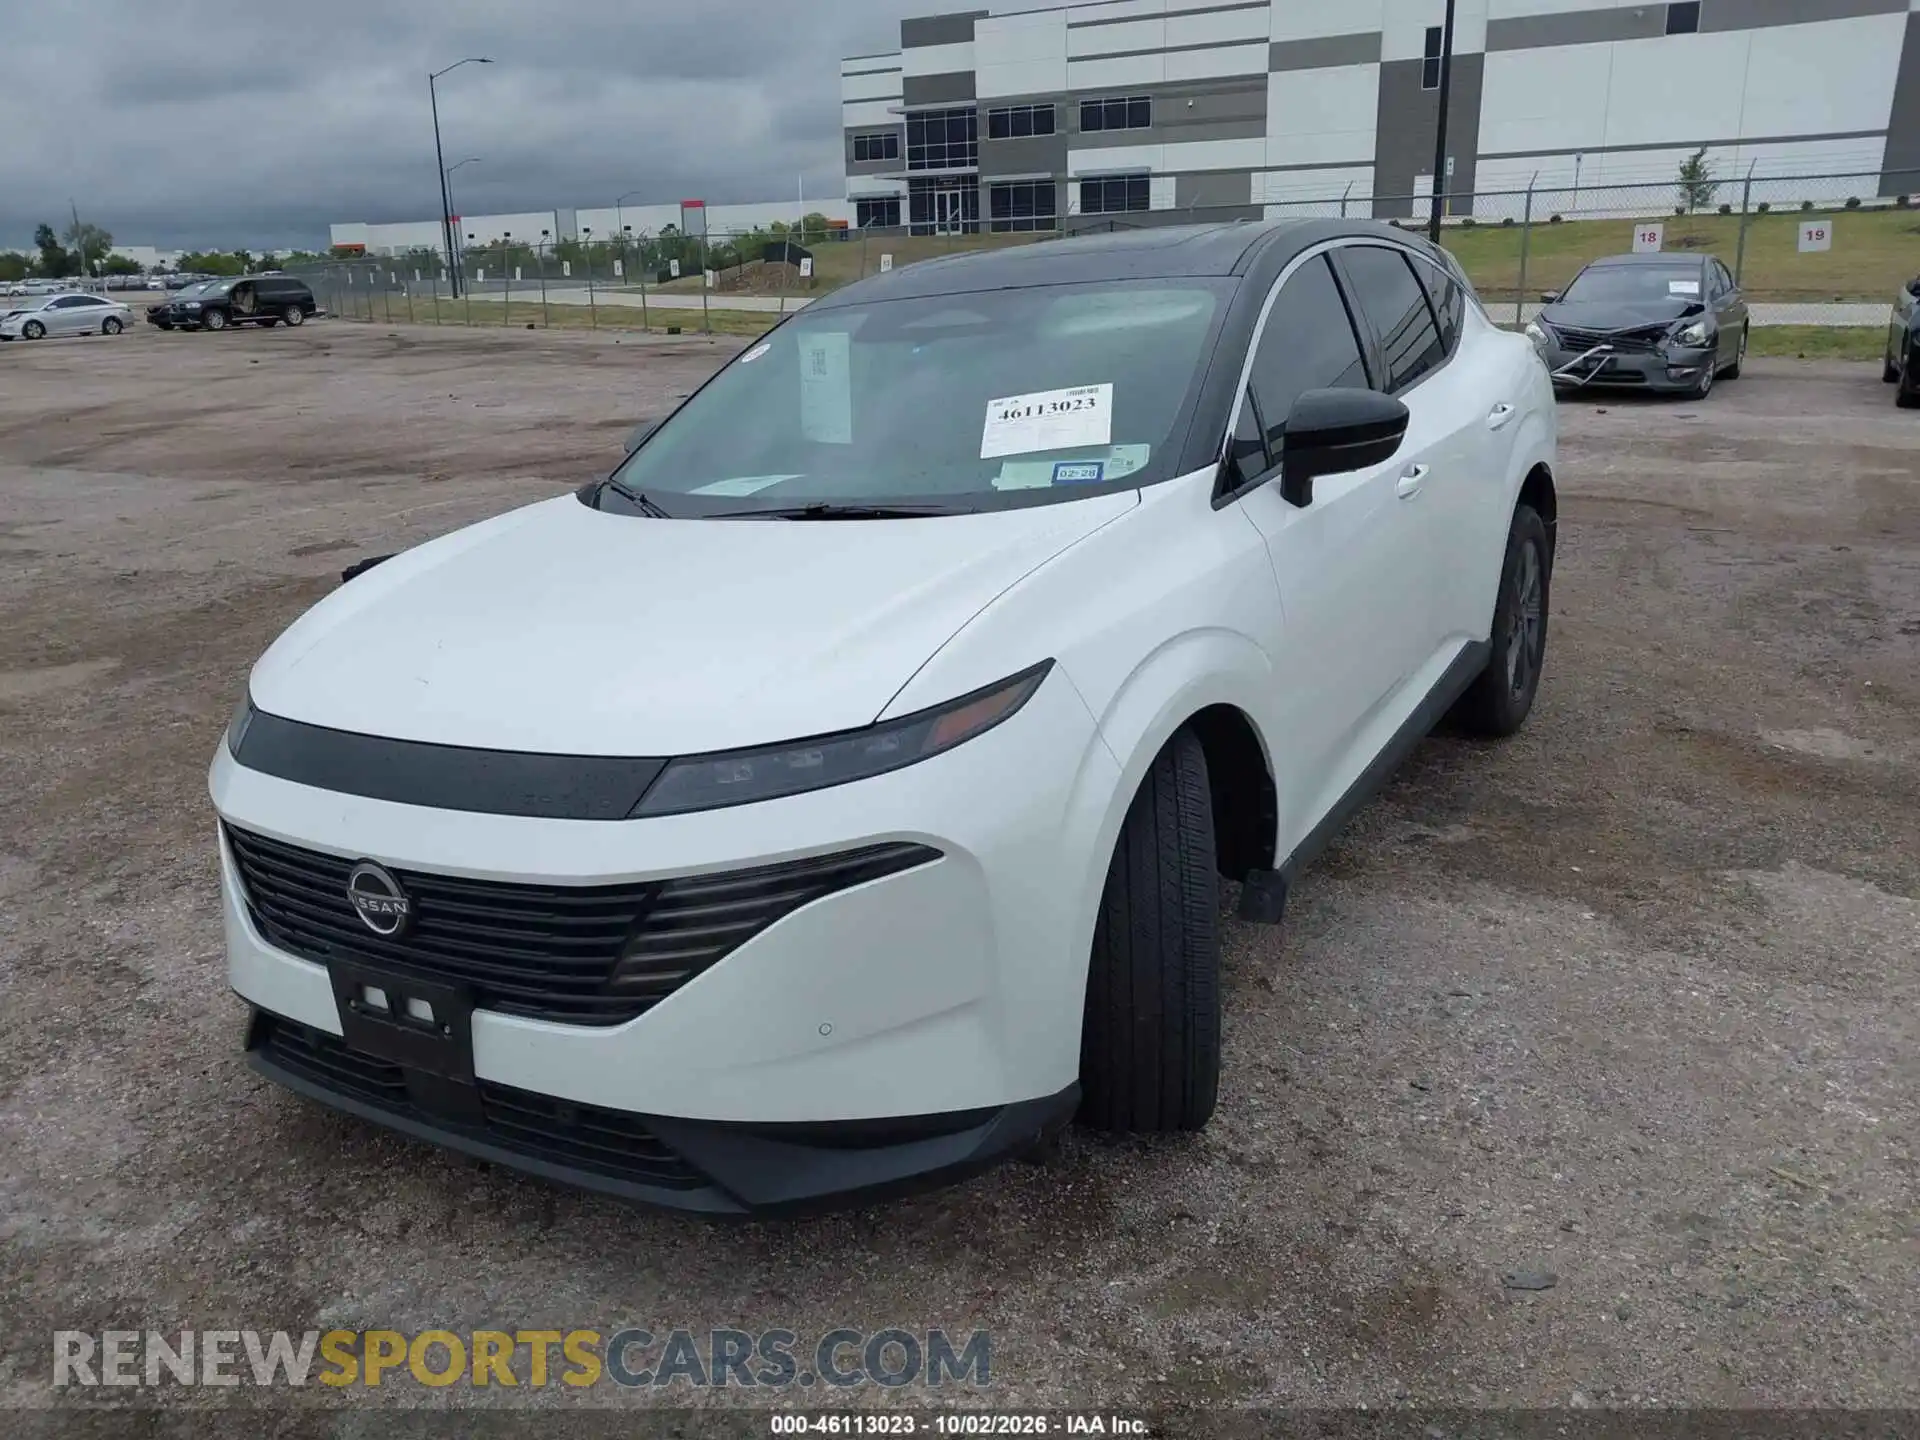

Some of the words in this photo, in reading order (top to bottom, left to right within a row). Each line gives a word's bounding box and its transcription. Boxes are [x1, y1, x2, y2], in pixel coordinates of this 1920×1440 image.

[1640, 232, 1656, 243] 18
[1806, 230, 1825, 241] 19
[998, 398, 1096, 420] 46113023
